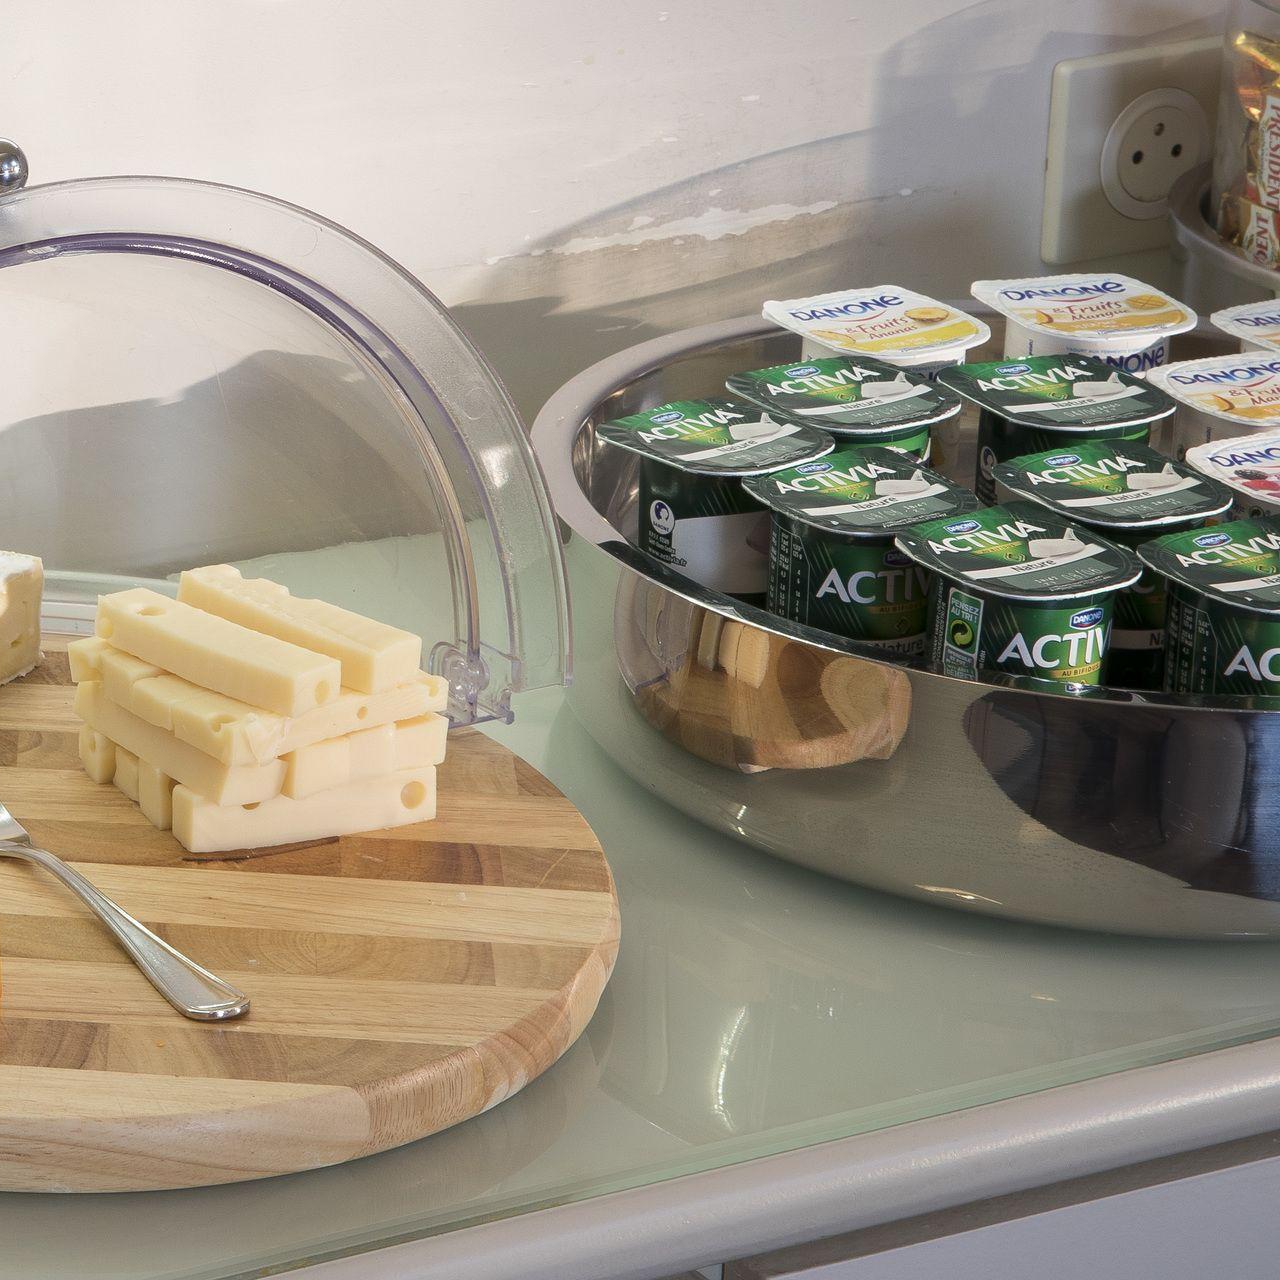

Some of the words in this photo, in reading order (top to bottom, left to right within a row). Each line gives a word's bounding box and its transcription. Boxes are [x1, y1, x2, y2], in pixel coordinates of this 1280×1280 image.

[1000, 281, 1126, 301] DANONE
[790, 295, 904, 321] DANONE
[1066, 300, 1122, 315] Fruits
[1071, 308, 1130, 321] Mangue
[858, 316, 908, 334] Fruits
[1234, 314, 1280, 327] DAN
[868, 324, 918, 340] Ananas
[766, 365, 881, 396] ACTIVIA
[976, 364, 1094, 392] ACTIVIA
[1241, 384, 1280, 397] Frui
[841, 397, 883, 410] Nature
[1052, 397, 1094, 409] Nature
[1250, 396, 1280, 406] Man
[637, 407, 745, 445] ACTIVIA
[720, 438, 758, 453] Nature
[1206, 448, 1280, 467] DANO
[775, 462, 896, 494] ACTIVIA
[1026, 454, 1147, 486] ACTIVIA
[853, 496, 897, 510] Nature
[1106, 489, 1151, 503] Nature
[945, 521, 980, 533] DANONE
[927, 519, 1047, 555] ACTIVIA
[1012, 558, 1056, 574] Nature
[816, 567, 931, 604] ACTIV
[951, 597, 980, 616] PENSEZ
[951, 607, 960, 616] AU
[961, 611, 973, 622] TRI
[1073, 609, 1102, 627] DANONE
[997, 628, 1108, 669] ACTIV
[1062, 669, 1072, 677] AU
